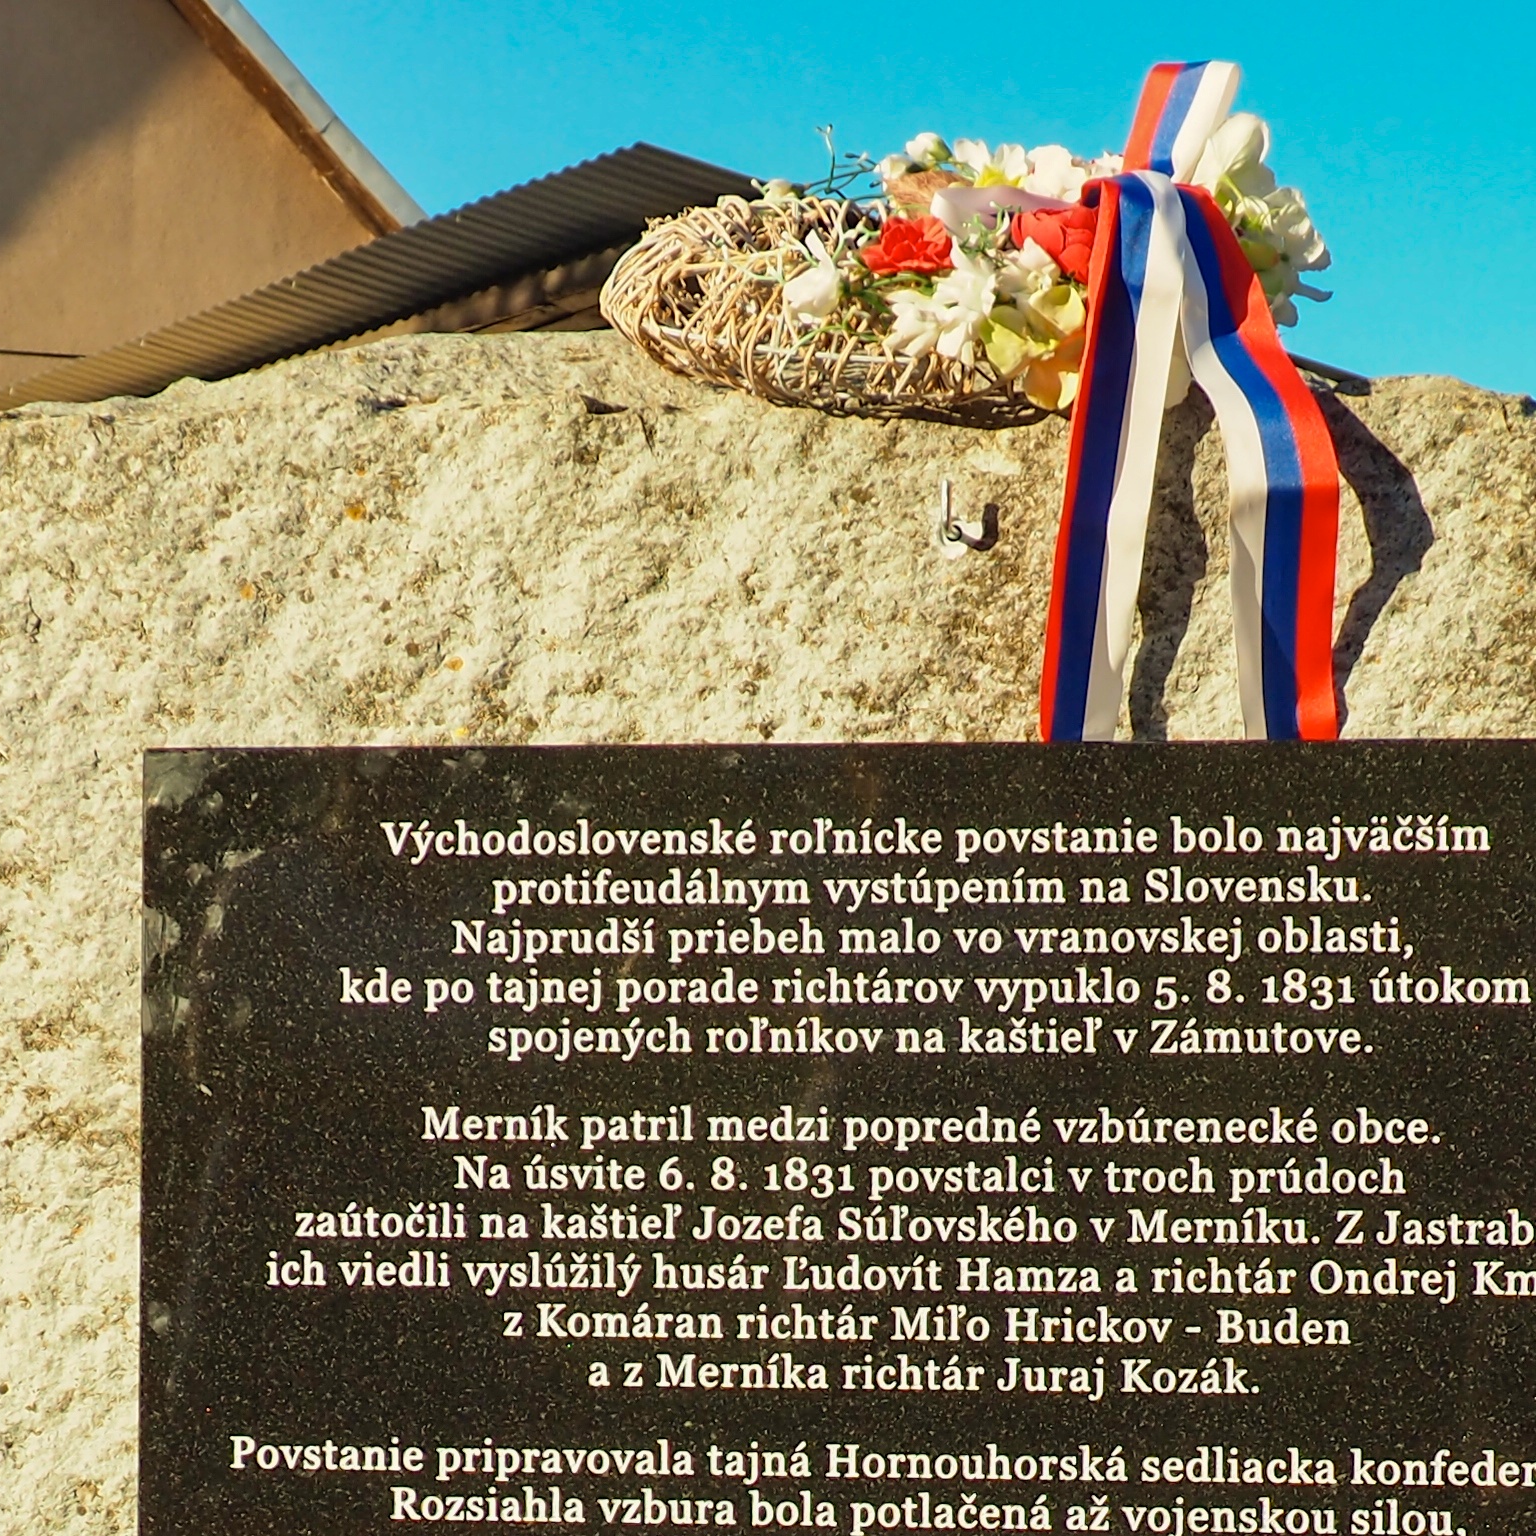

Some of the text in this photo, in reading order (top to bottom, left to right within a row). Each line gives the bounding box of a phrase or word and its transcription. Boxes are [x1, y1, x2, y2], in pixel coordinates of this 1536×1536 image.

[379, 814, 1491, 865] Východoslovenské roľnícke povstanie bolo najväčším
[491, 865, 1372, 915] protifeudálnym vystúpením na Slovensku.
[451, 915, 1414, 964] Najprudší priebeh malo vo vranovskej oblasti,
[338, 965, 1532, 1013] kde po tajnej porade richtárov vypuklo 5. 8. 1831 útokom
[488, 1016, 1374, 1062] spojených roľníkov na kaštieľ v Zámutove.
[421, 1104, 1441, 1152] Merník patril medzi popredné vzbúrenecké obce.
[452, 1153, 1407, 1203] Na úsvite 6. 8. 1831 povstalci v troch prúdoch
[294, 1201, 467, 1239] zaútočili
[479, 1213, 529, 1239] na
[540, 1202, 682, 1240] kaštieľ
[692, 1204, 825, 1241] Jozefa
[837, 1204, 1078, 1243] Súľovského
[1089, 1217, 1116, 1243] v
[1126, 1206, 1320, 1245] Merníku.
[1334, 1209, 1364, 1244] Z
[265, 1249, 327, 1286] ich
[337, 1250, 451, 1287] viedli
[461, 1251, 642, 1298] vyslúžilý
[652, 1252, 770, 1290] husár
[782, 1253, 943, 1292] Ľudovít
[956, 1257, 1102, 1293] Hamza
[1115, 1267, 1138, 1293] a
[1151, 1256, 1297, 1294] richtár
[1309, 1258, 1456, 1305] Ondrej
[502, 1311, 523, 1337] z
[536, 1302, 724, 1339] Komáran
[736, 1303, 879, 1341] richtár
[890, 1304, 990, 1342] Miľo
[1004, 1305, 1173, 1343] Hrickov
[1216, 1307, 1352, 1347] Buden
[588, 1352, 1260, 1401] a z Merníka richtár Juraj Kozák.
[229, 1435, 424, 1472] Povstanie
[435, 1437, 695, 1482] pripravovala
[706, 1440, 812, 1486] tajná
[825, 1443, 1129, 1482] Hornouhorská
[1141, 1445, 1338, 1485] sedliacka
[389, 1485, 586, 1523] Rozsiahla
[596, 1487, 737, 1526] vzbura
[748, 1489, 838, 1527] bola
[849, 1491, 1052, 1536] potlačená
[1065, 1494, 1110, 1531] až
